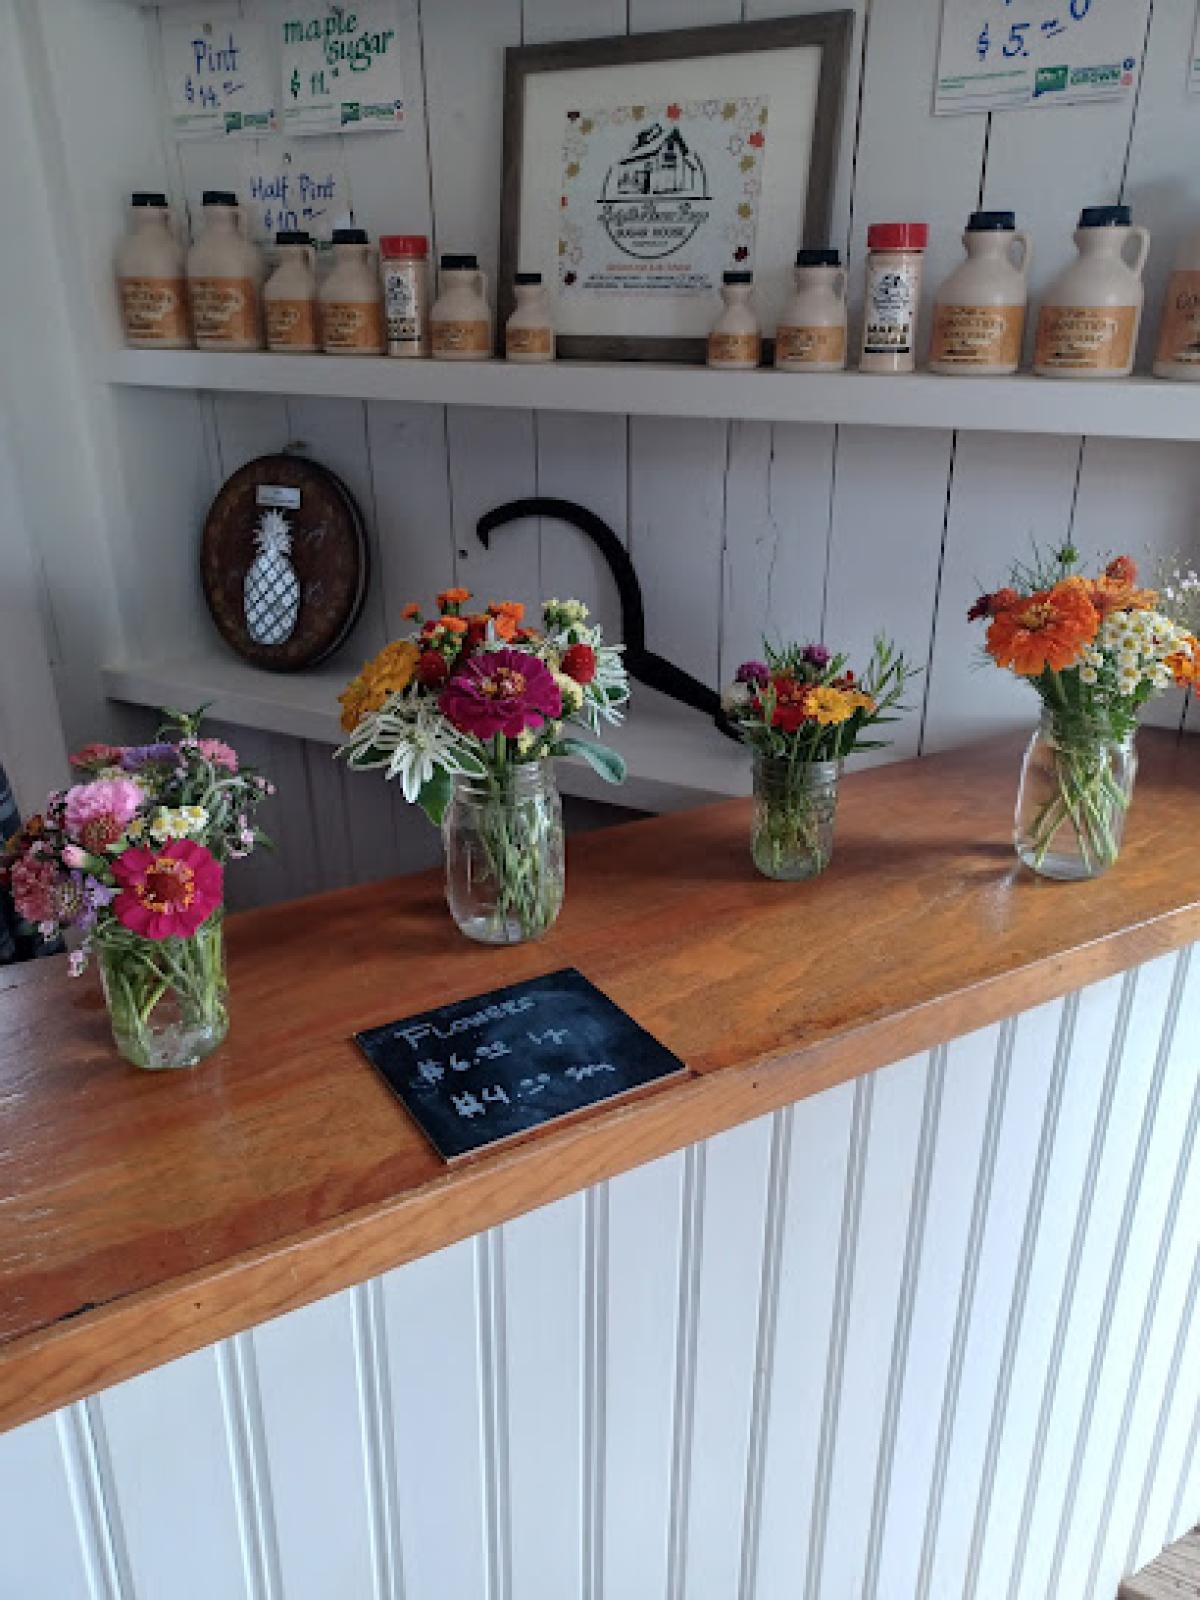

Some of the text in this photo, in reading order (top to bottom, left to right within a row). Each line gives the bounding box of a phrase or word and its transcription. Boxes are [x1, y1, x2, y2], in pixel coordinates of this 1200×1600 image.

[284, 5, 358, 50] maple
[191, 33, 240, 74] Pint
[325, 29, 395, 71] sugar
[251, 173, 336, 207] Half Pint
